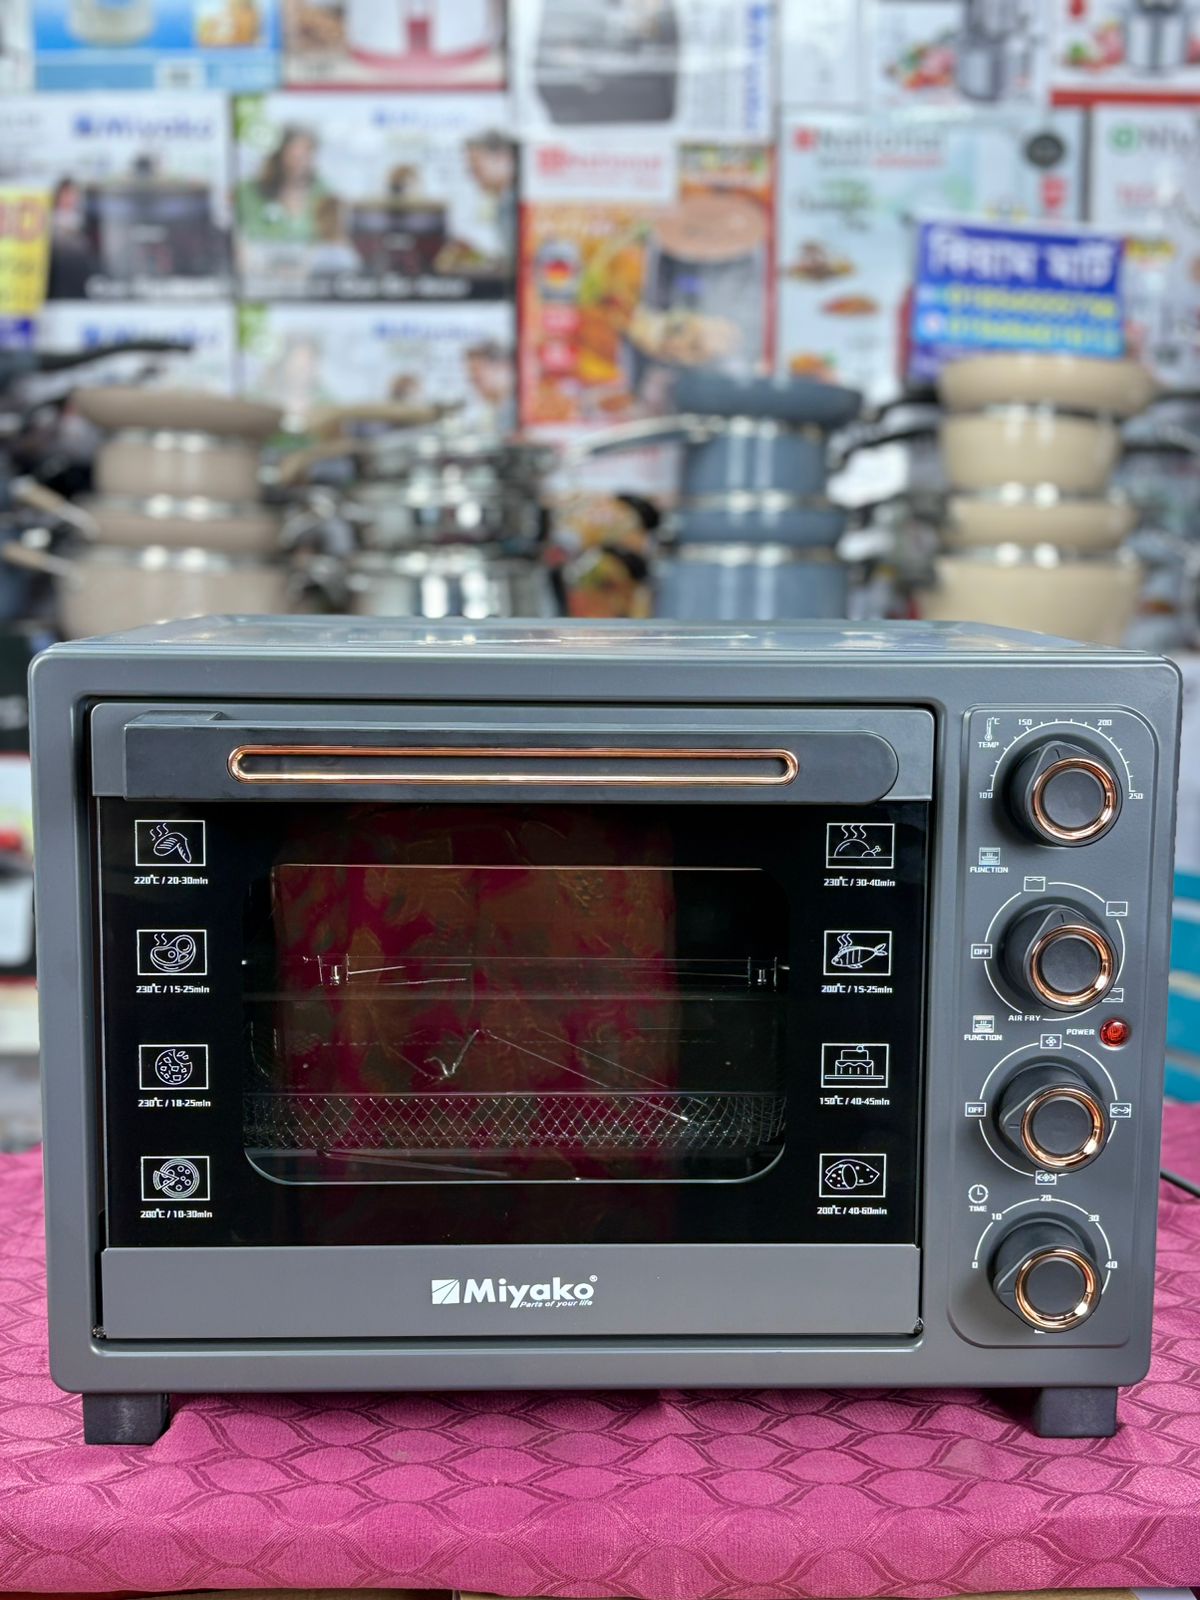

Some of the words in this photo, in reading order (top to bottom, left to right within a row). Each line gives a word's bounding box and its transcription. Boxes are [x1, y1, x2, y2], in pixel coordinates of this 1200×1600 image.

[1018, 718, 1032, 726] 150
[1097, 718, 1112, 726] 200
[969, 866, 1009, 874] FUNCTION
[167, 876, 209, 885] 20-30min
[855, 878, 896, 887] 30-40min
[169, 985, 210, 993] 15-25min
[853, 985, 893, 993] 15-25min
[1008, 1014, 1023, 1022] AIR
[1024, 1014, 1041, 1022] FRY
[1066, 1028, 1095, 1036] POWER
[850, 1097, 890, 1106] 40-45min
[848, 1207, 888, 1215] 40-60min
[463, 1276, 595, 1308] Miyako
[519, 1300, 543, 1308] Parts
